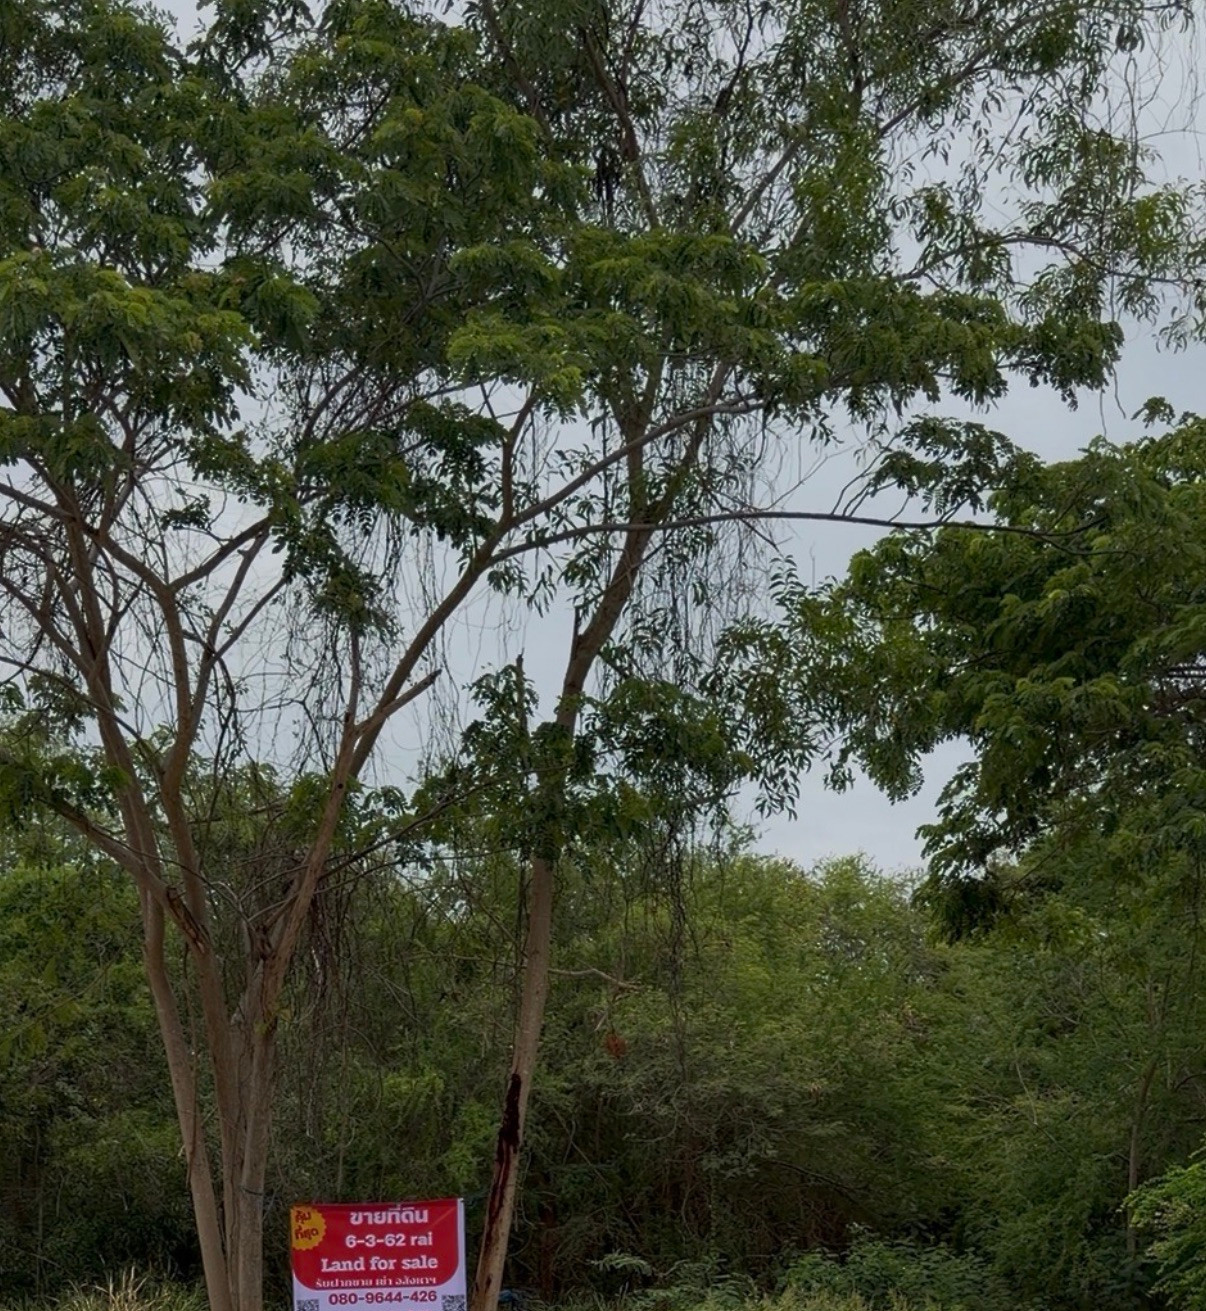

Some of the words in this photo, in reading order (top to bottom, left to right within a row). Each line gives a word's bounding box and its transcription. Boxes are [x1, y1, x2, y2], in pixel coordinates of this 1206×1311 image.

[350, 1204, 429, 1225] ขายที่ดิน
[345, 1233, 406, 1248] 6-3-62
[410, 1231, 433, 1246] rai
[321, 1257, 366, 1272] Land
[370, 1256, 397, 1271] for
[401, 1254, 438, 1270] sale
[328, 1290, 438, 1305] 080-9644-426
